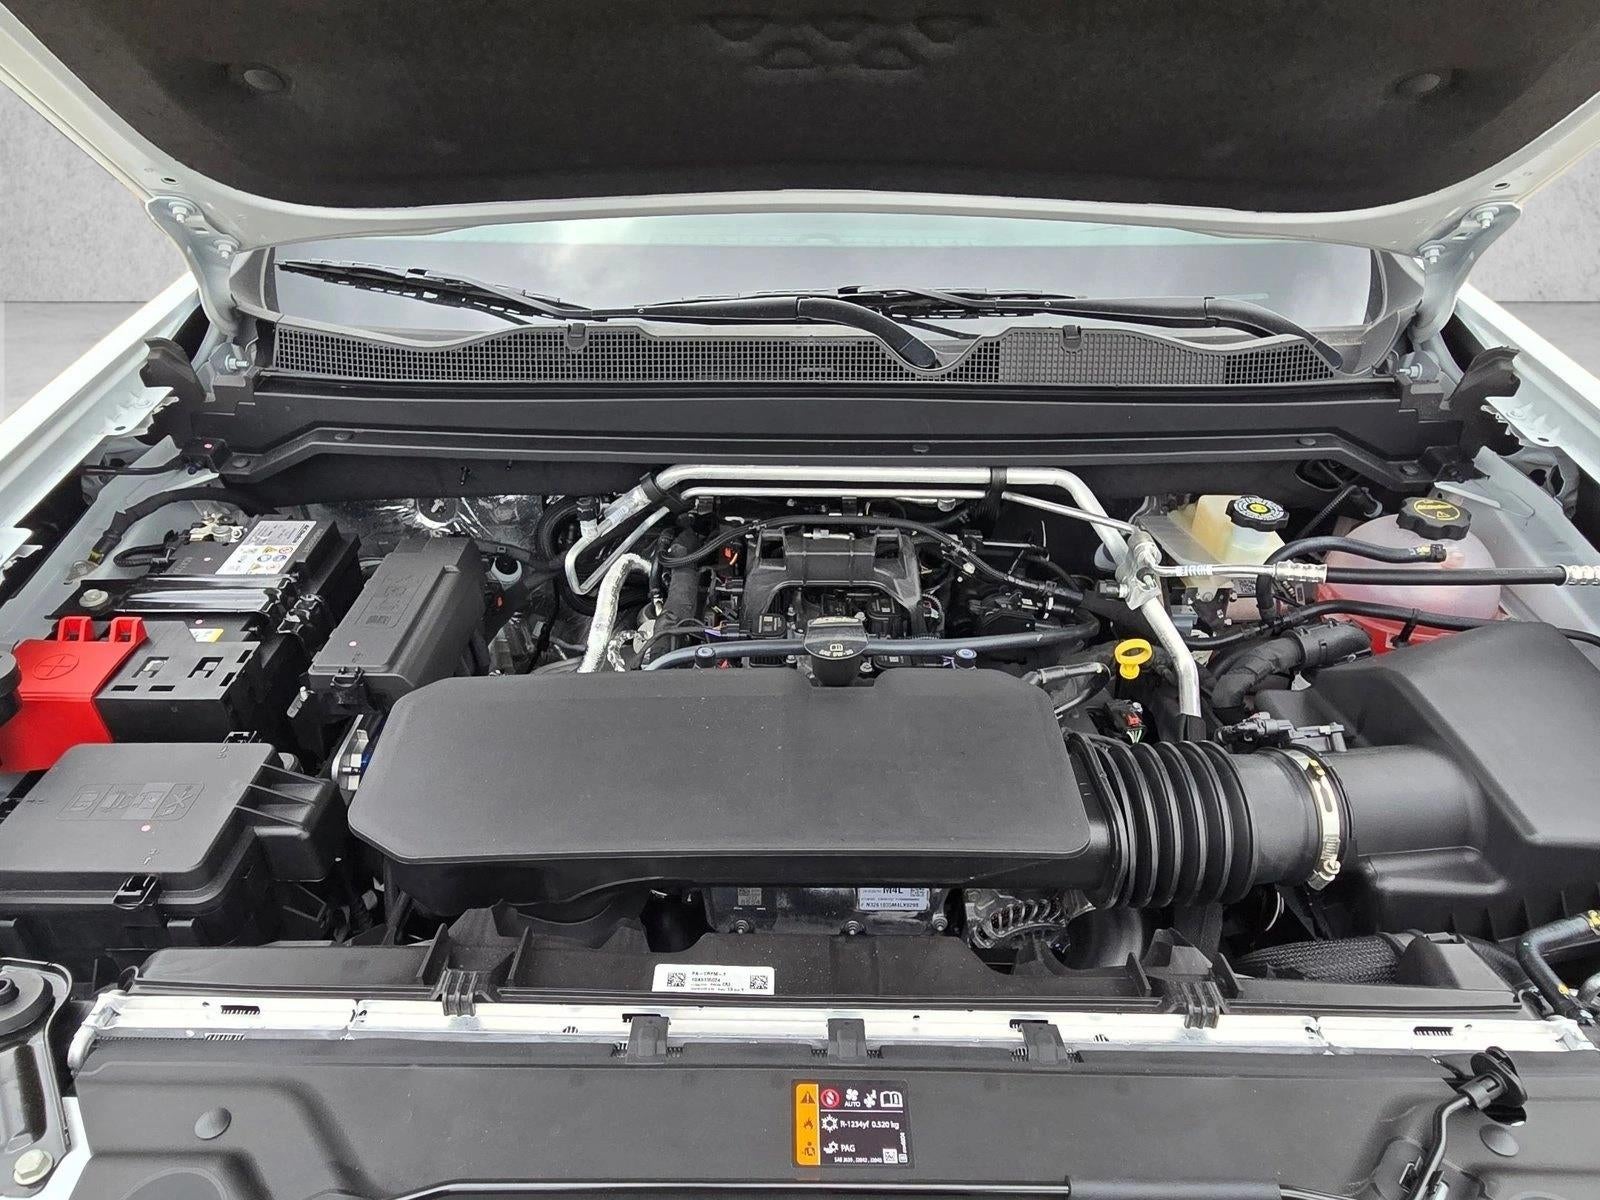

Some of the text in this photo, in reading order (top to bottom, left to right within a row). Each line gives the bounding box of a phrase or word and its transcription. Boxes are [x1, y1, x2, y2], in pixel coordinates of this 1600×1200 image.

[840, 1120, 900, 1131] R-1234yf 0.520 kg
[840, 1144, 856, 1153] PAG
